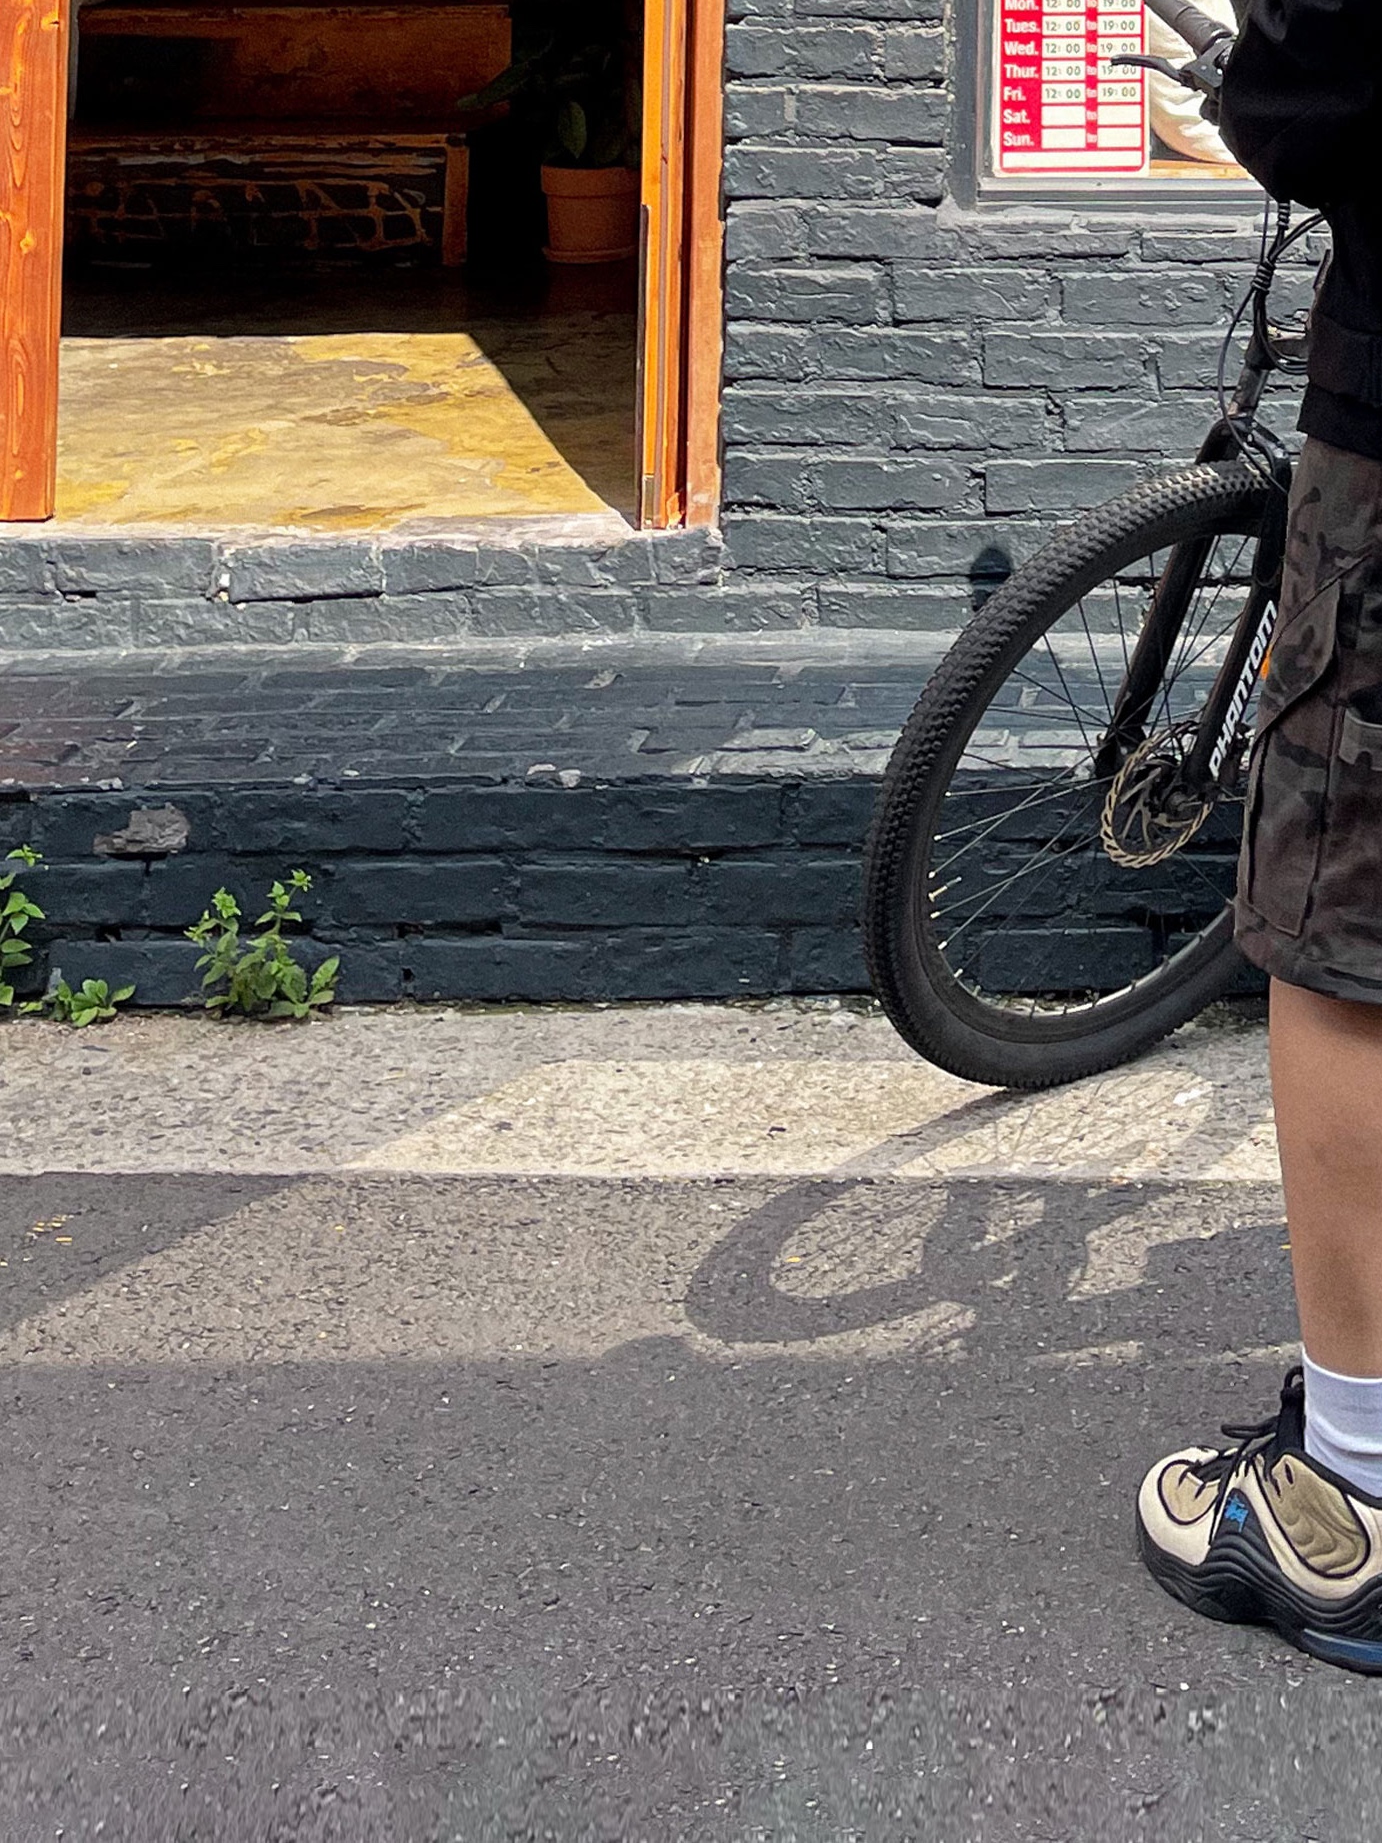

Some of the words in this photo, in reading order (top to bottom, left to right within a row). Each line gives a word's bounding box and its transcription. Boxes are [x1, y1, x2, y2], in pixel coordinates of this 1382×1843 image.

[1004, 18, 1040, 33] Tues.
[1004, 41, 1039, 55] Wed.
[1004, 64, 1039, 78] Thur.
[1004, 86, 1027, 101] Fri.
[1003, 109, 1031, 124] Sat.
[1003, 131, 1034, 146] Sun.
[1208, 600, 1277, 781] PHANTOM
